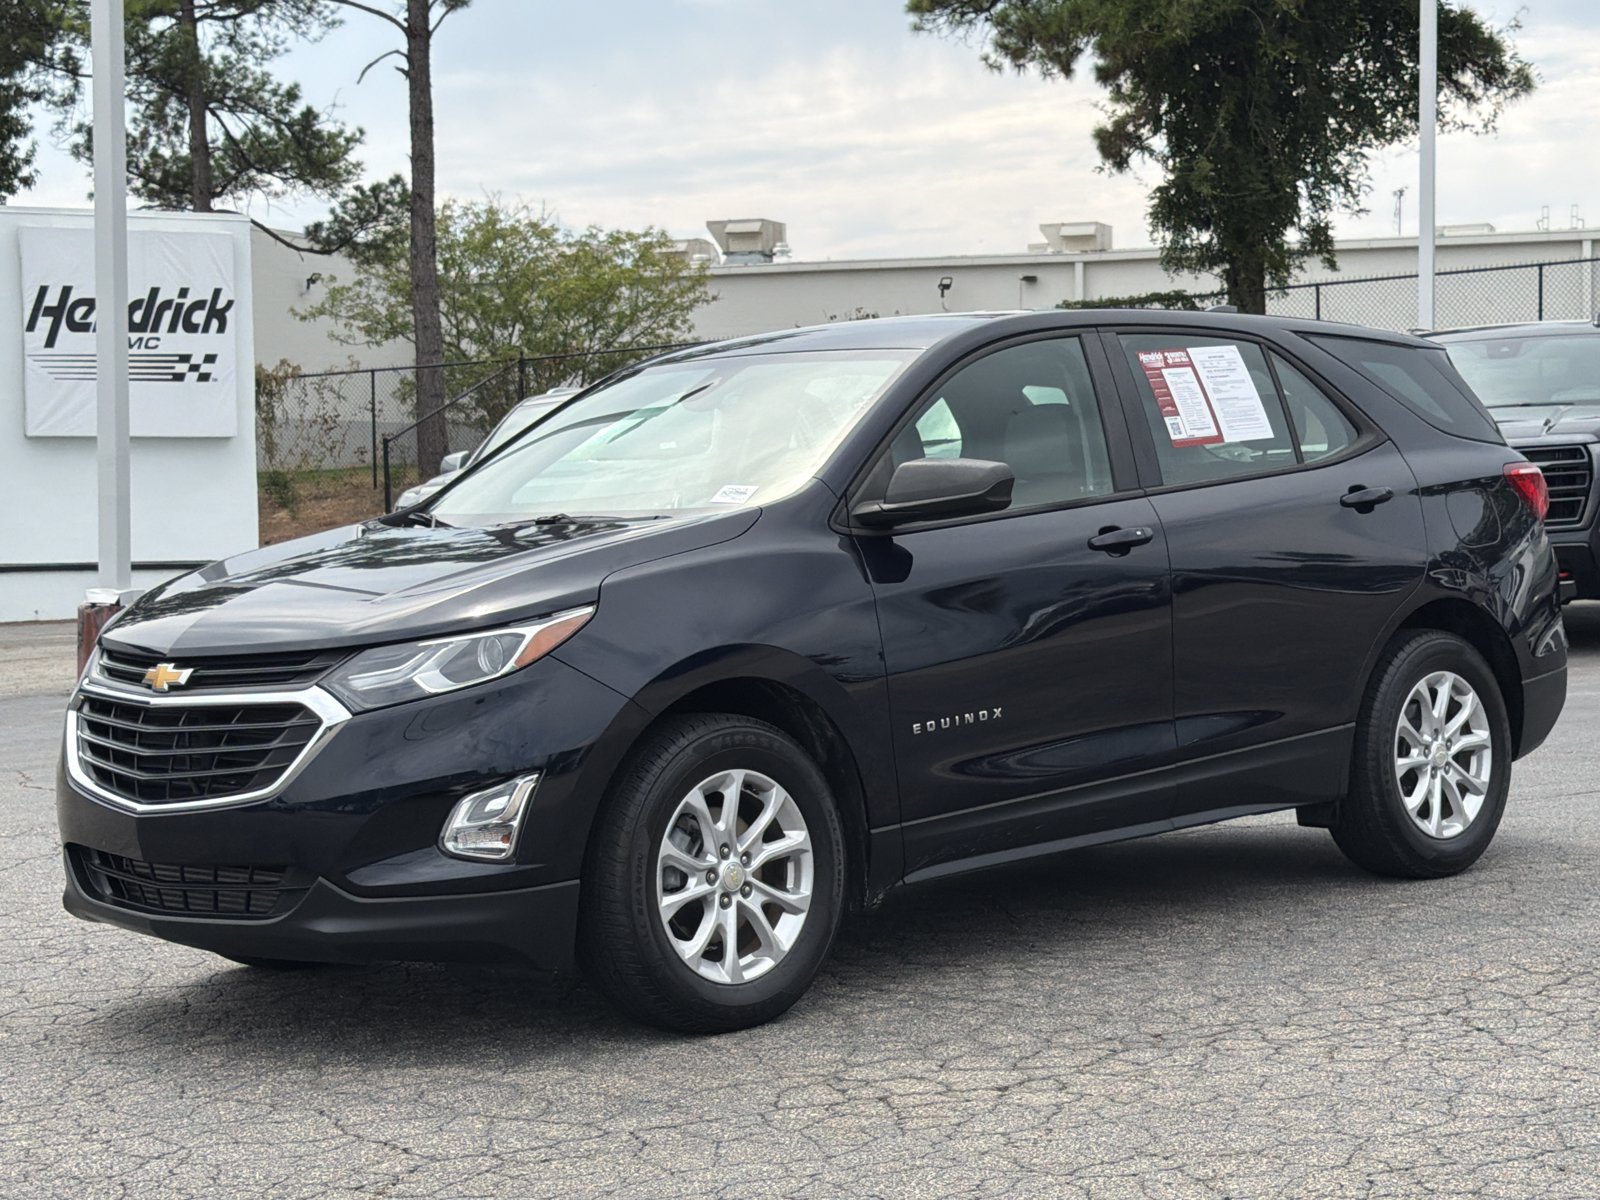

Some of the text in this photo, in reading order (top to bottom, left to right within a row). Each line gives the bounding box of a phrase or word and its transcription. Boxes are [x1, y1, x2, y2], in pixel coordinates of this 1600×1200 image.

[25, 285, 235, 348] Hedrick
[127, 336, 161, 350] MC
[912, 707, 1002, 735] EQUINOX
